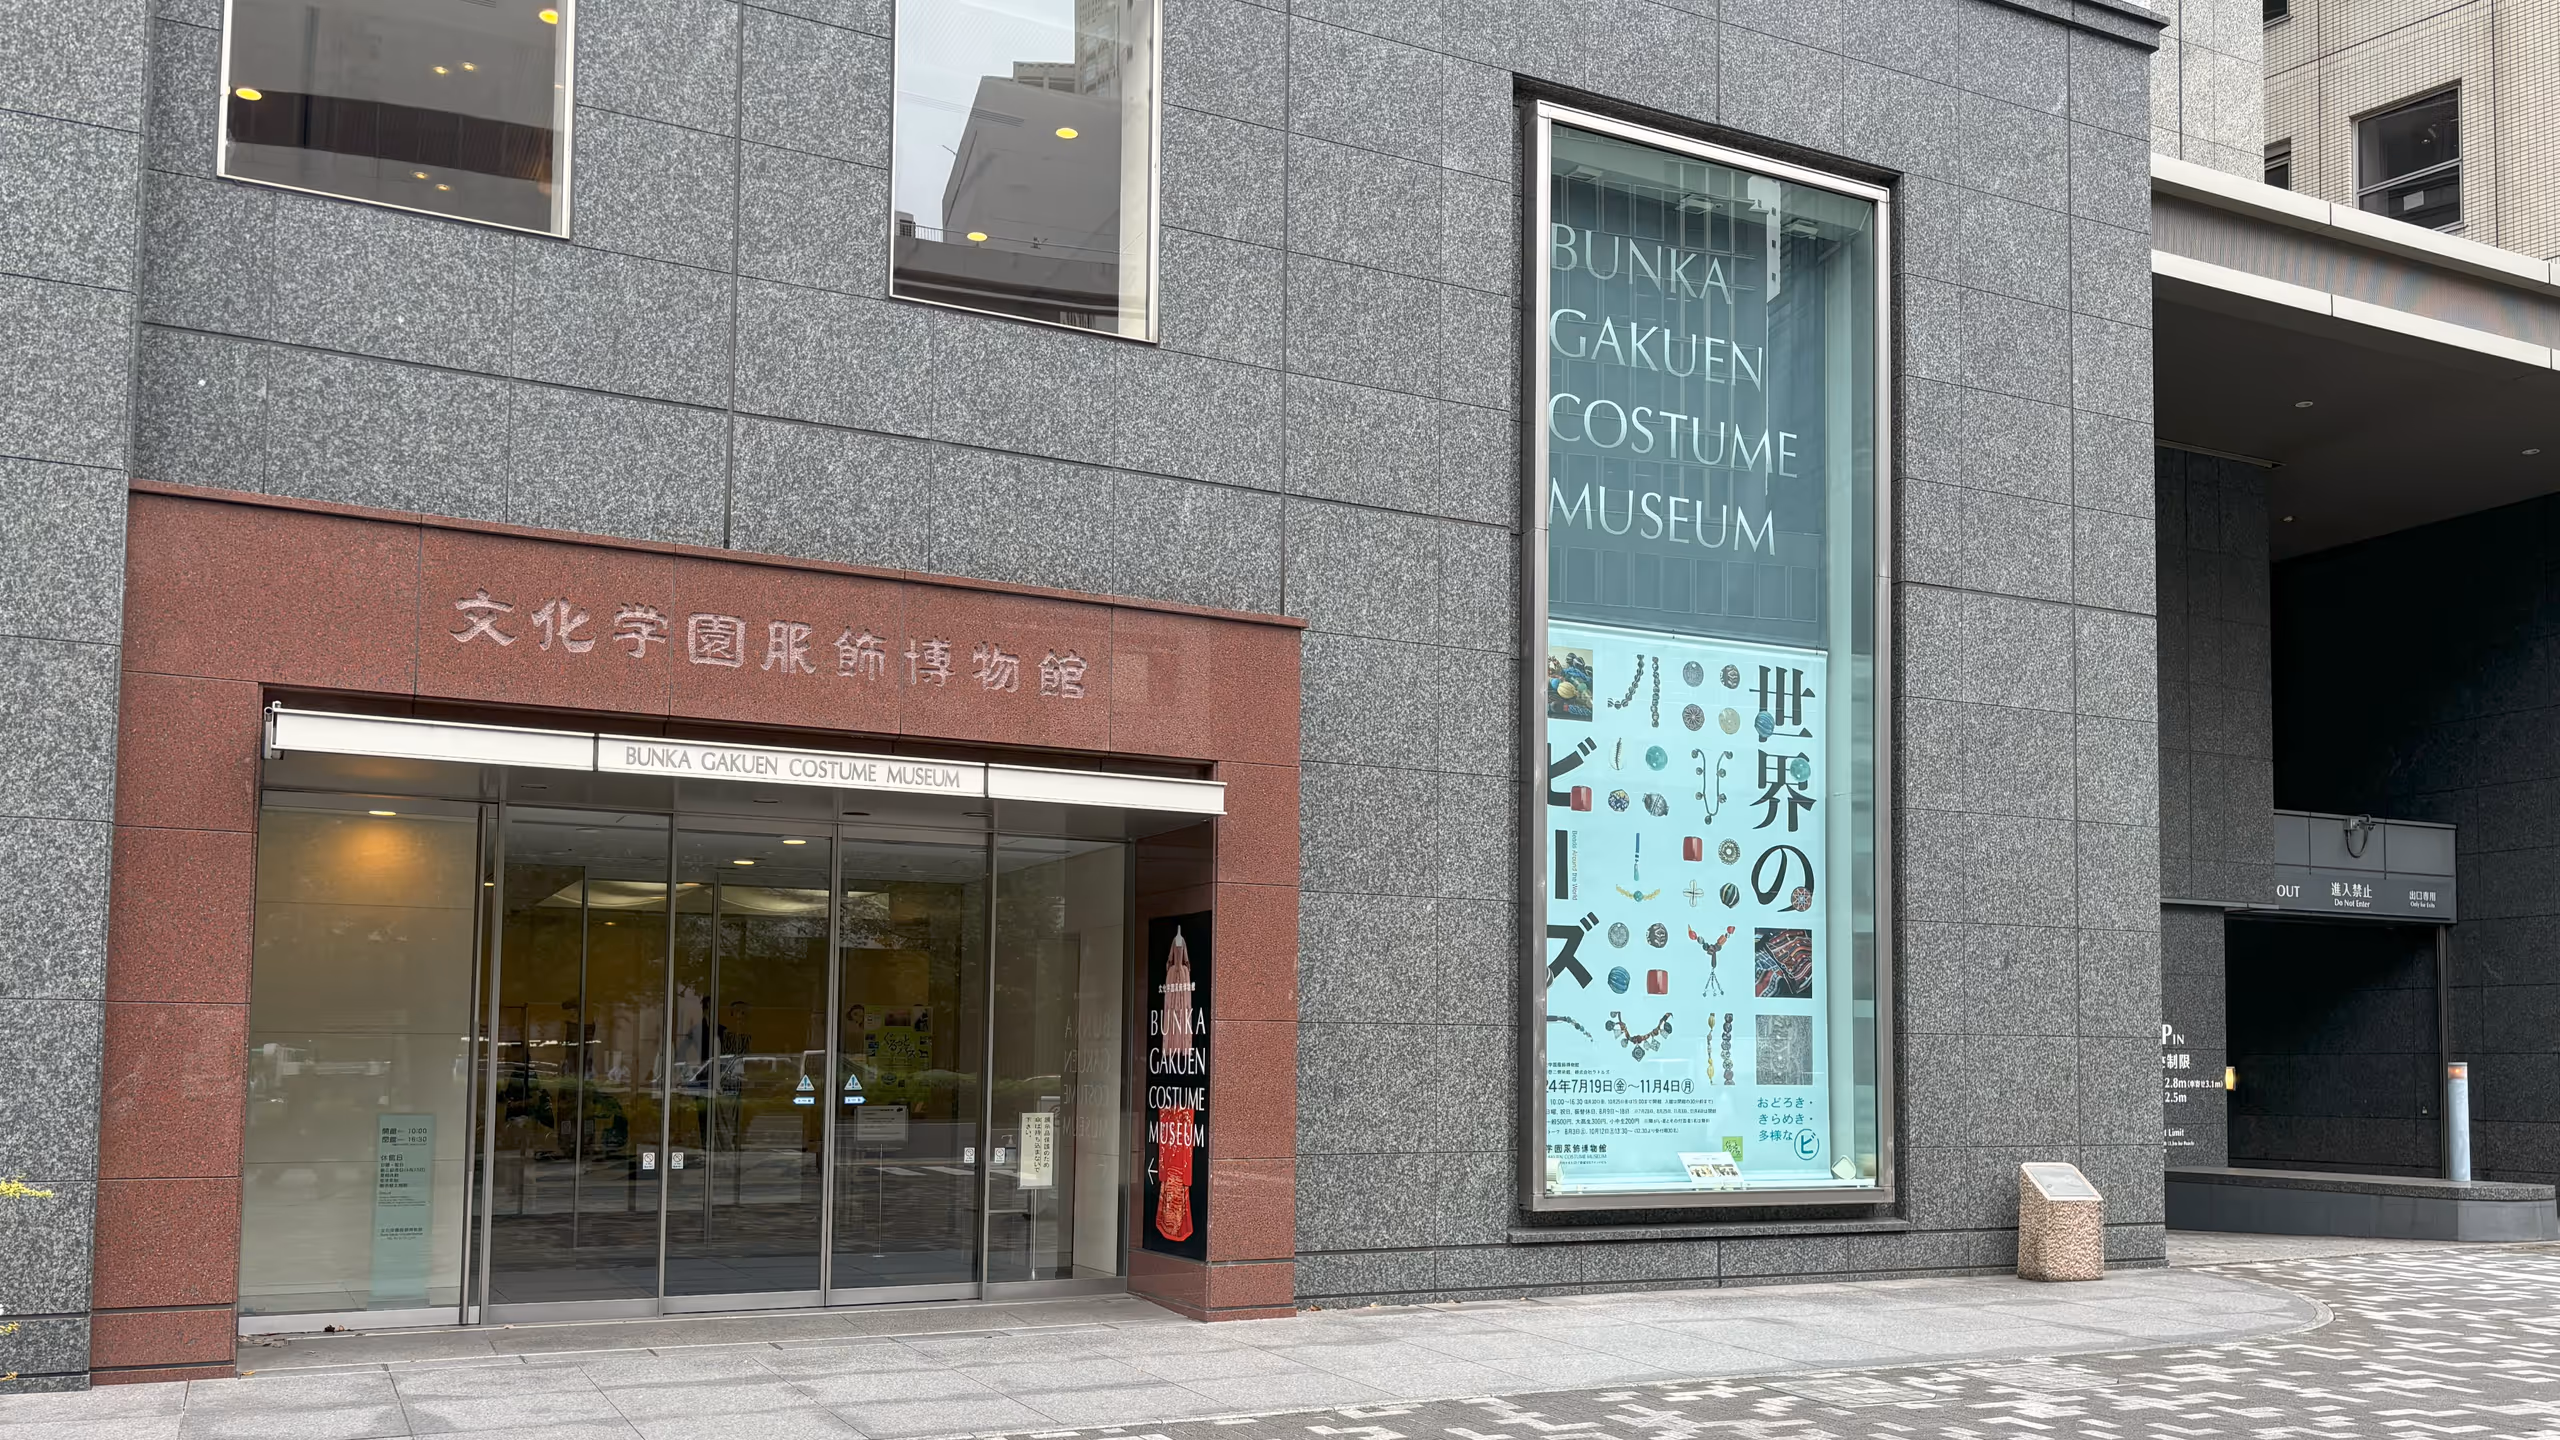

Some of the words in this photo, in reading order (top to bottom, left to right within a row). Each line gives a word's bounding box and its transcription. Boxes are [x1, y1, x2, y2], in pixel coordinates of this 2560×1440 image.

[1550, 223, 1732, 304] BUNKA
[1549, 308, 1763, 392] GAKUEN
[1548, 393, 1798, 478] COSTUME
[1548, 477, 1776, 556] MUSEUM
[449, 586, 1088, 700] 文化学園服飾博物館
[625, 746, 692, 769] BUNKA
[701, 752, 778, 775] GAKUEN
[789, 758, 876, 782] COSTUME
[886, 765, 960, 788] MUSEUM
[1749, 665, 1817, 912] 世界の
[2276, 885, 2300, 898] OUT
[2331, 882, 2373, 899] 進入禁止
[2334, 899, 2343, 907] Do
[2344, 900, 2355, 908] Not
[2409, 890, 2436, 901] 出口専用
[1150, 1007, 1206, 1036] BUNKA
[1149, 1047, 1206, 1075] GAKUEN
[1148, 1086, 1205, 1111] COSTUME
[2164, 1092, 2187, 1103] 2.5m
[408, 1127, 428, 1135] 10:00
[1148, 1120, 1205, 1148] MUSEUM
[2168, 1128, 2185, 1137] Limit
